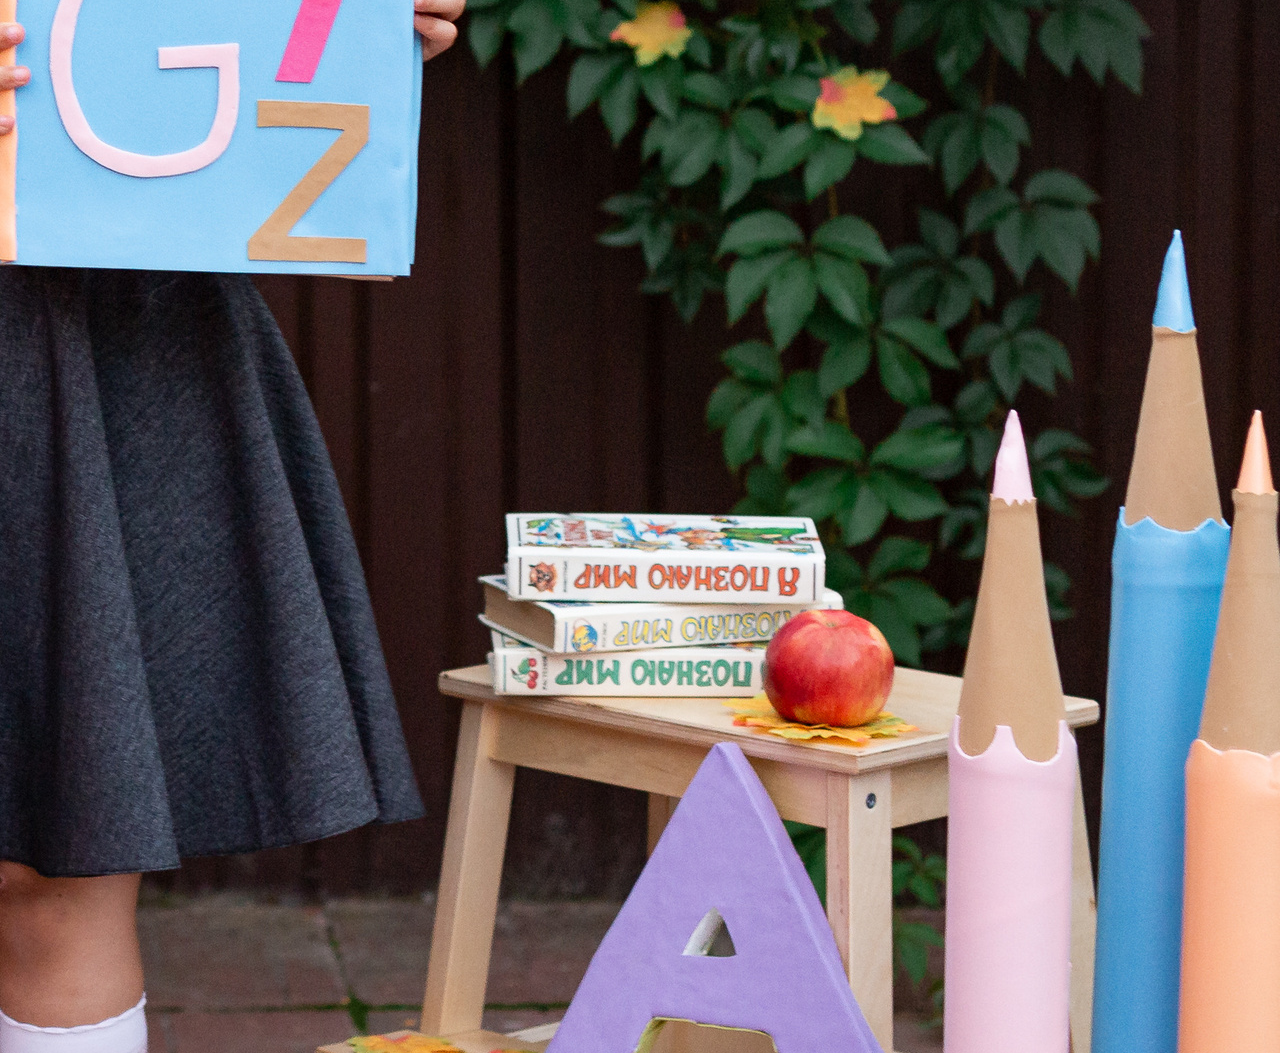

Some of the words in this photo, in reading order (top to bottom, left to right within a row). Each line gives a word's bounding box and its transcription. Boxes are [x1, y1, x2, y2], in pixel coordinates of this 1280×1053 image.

[246, 100, 370, 264] Z
[574, 563, 638, 590] МИР
[648, 563, 770, 592] ПОЗНАЮ
[778, 566, 800, 596] Я
[613, 618, 672, 647] МИР
[554, 658, 621, 687] МИР
[630, 658, 753, 688] ПОЗНАЮ
